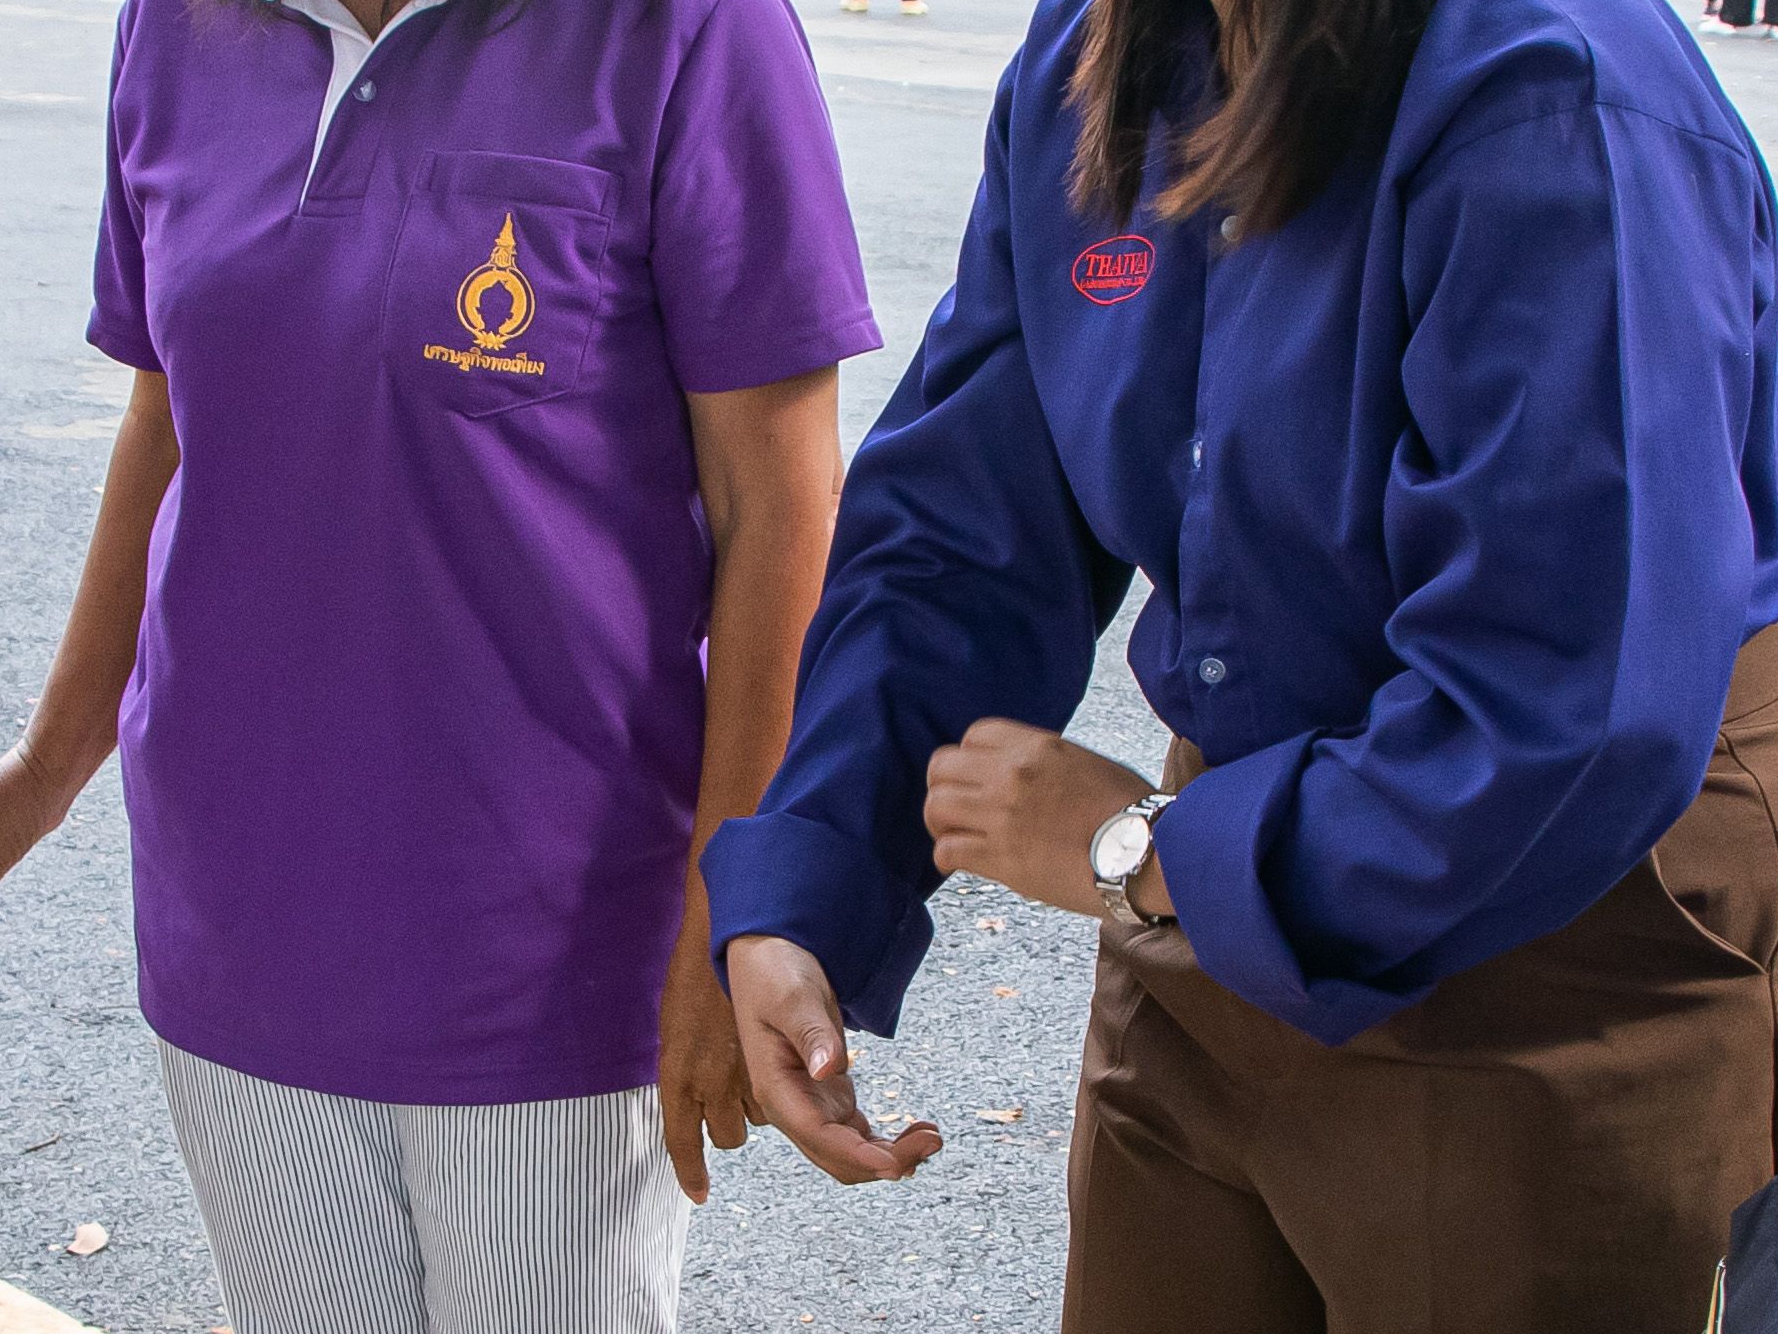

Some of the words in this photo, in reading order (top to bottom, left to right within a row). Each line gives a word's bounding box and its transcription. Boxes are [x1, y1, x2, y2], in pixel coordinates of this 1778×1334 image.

[423, 343, 546, 376] เศรษฐกิจพอเพียง
